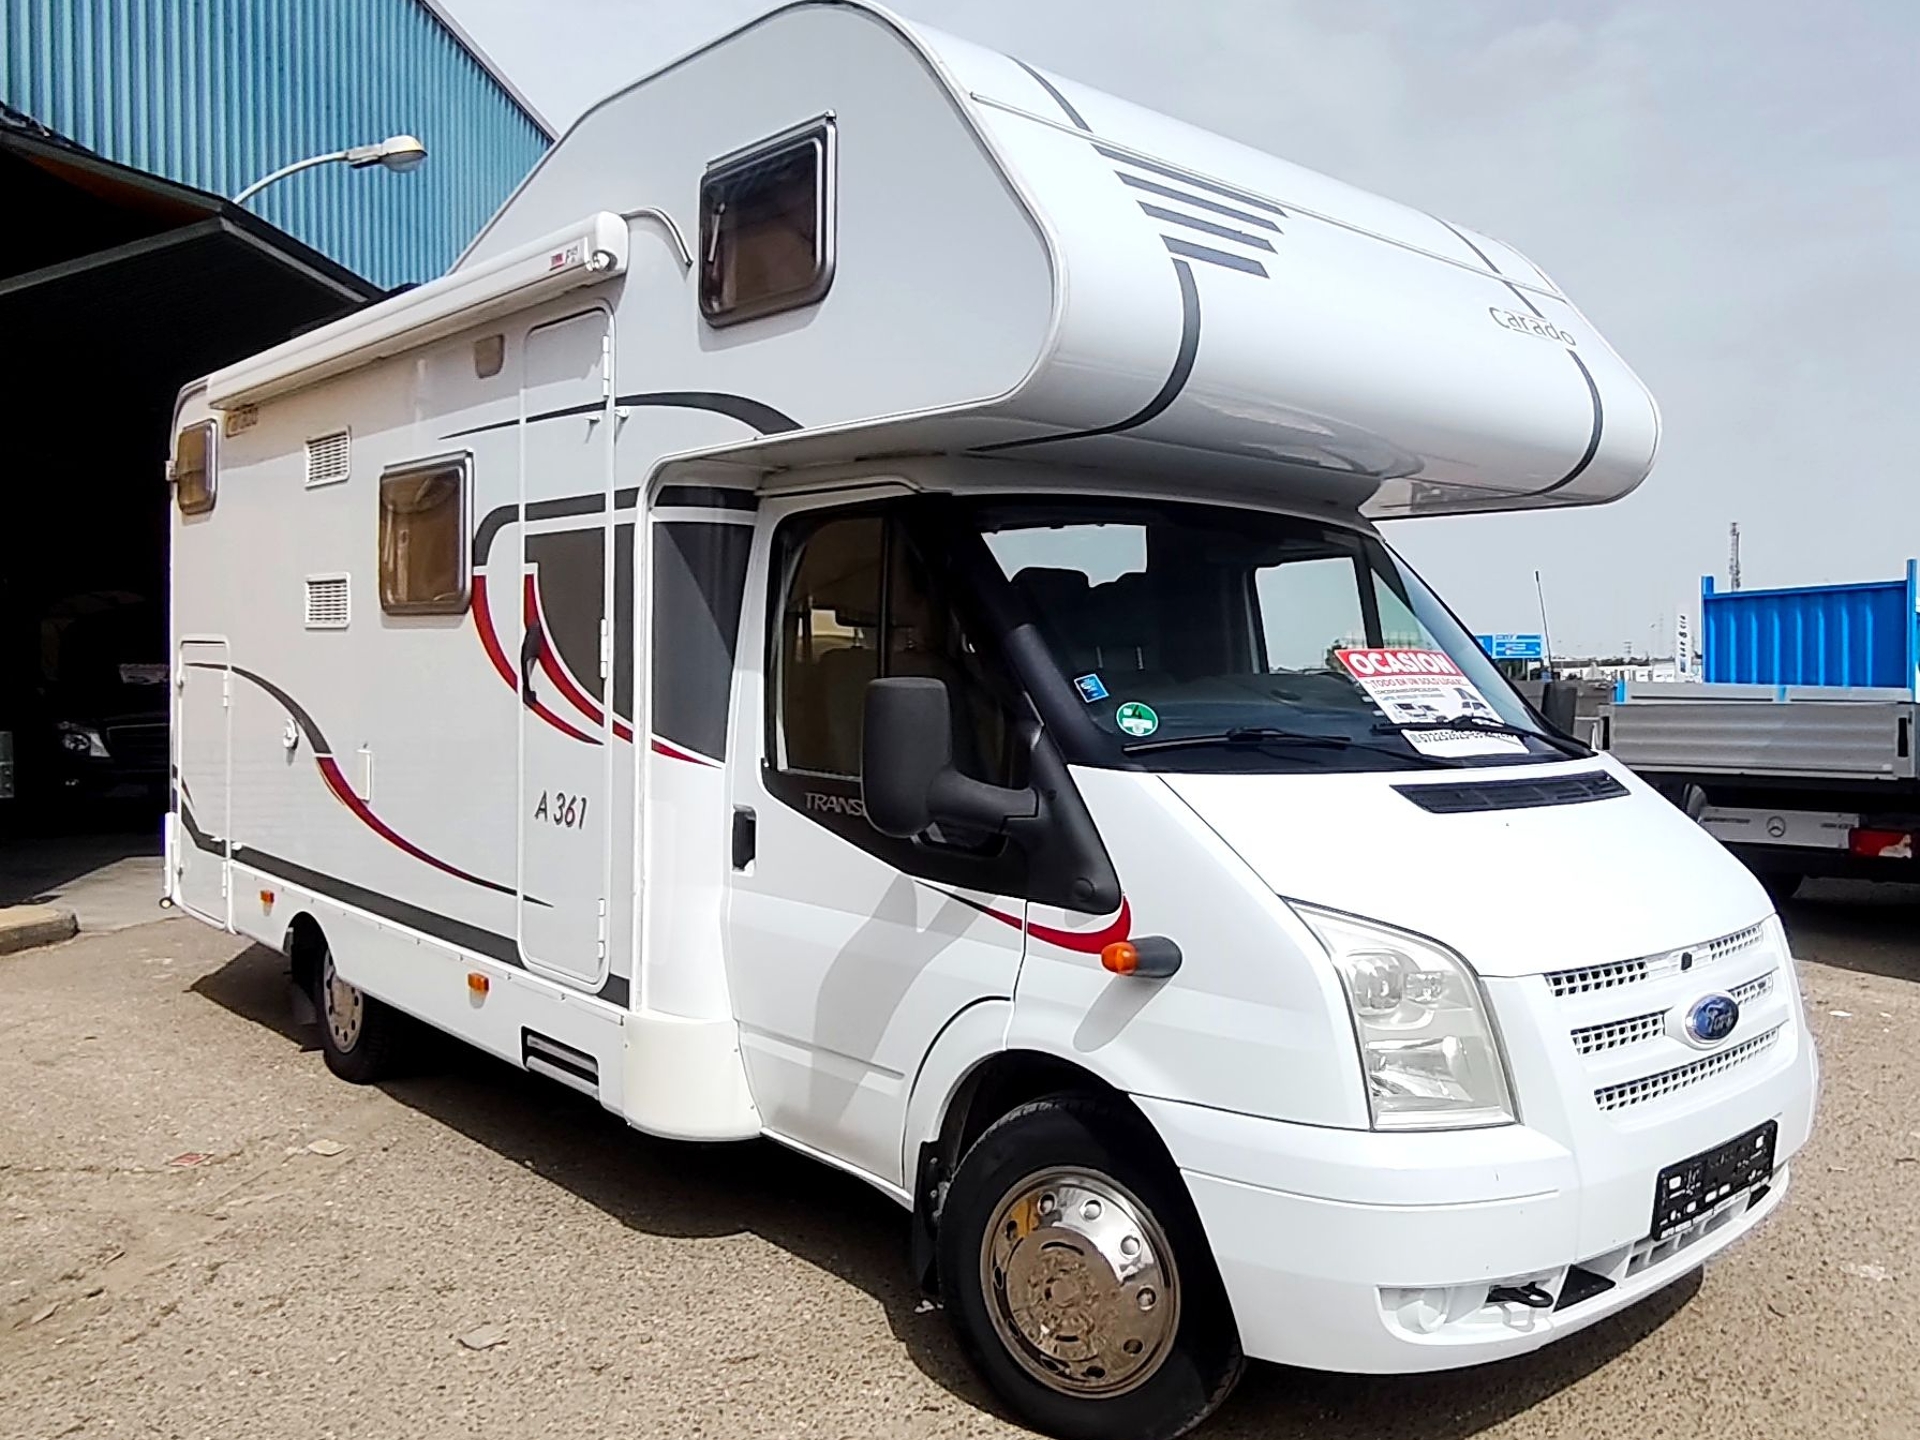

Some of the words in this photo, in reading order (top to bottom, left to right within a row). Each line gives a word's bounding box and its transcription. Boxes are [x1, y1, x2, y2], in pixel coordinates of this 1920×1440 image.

[1489, 307, 1576, 346] Carado
[1348, 652, 1457, 674] OCASION
[534, 790, 548, 822] A
[553, 792, 587, 830] 361
[804, 792, 866, 816] TRANS
